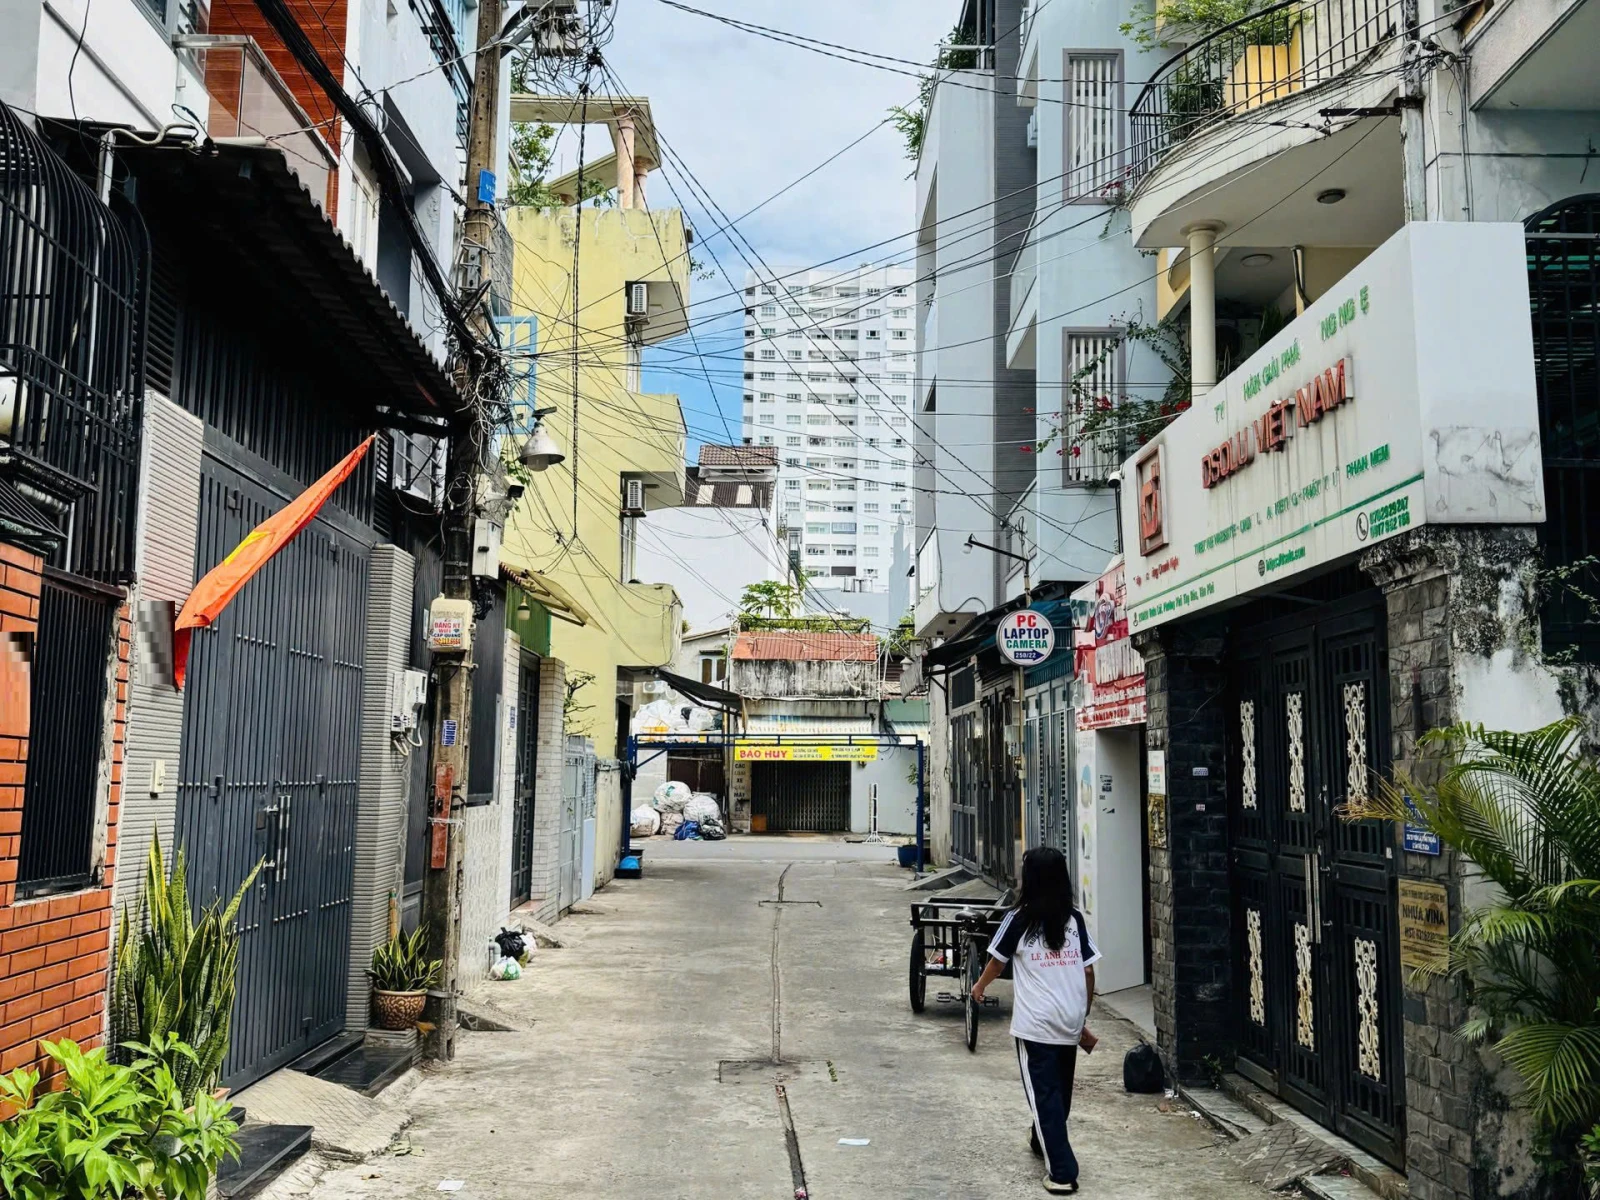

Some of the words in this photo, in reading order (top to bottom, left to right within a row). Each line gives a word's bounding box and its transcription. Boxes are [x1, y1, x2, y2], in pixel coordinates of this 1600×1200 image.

[1296, 357, 1351, 428] NAM
[1017, 614, 1037, 628] PC
[1004, 627, 1049, 640] LAPTOP
[1006, 639, 1048, 649] CAMERA
[764, 750, 788, 759] HUY
[1425, 908, 1446, 926] VINA
[1044, 951, 1061, 960] ANH
[1063, 949, 1081, 959] XUÂ
